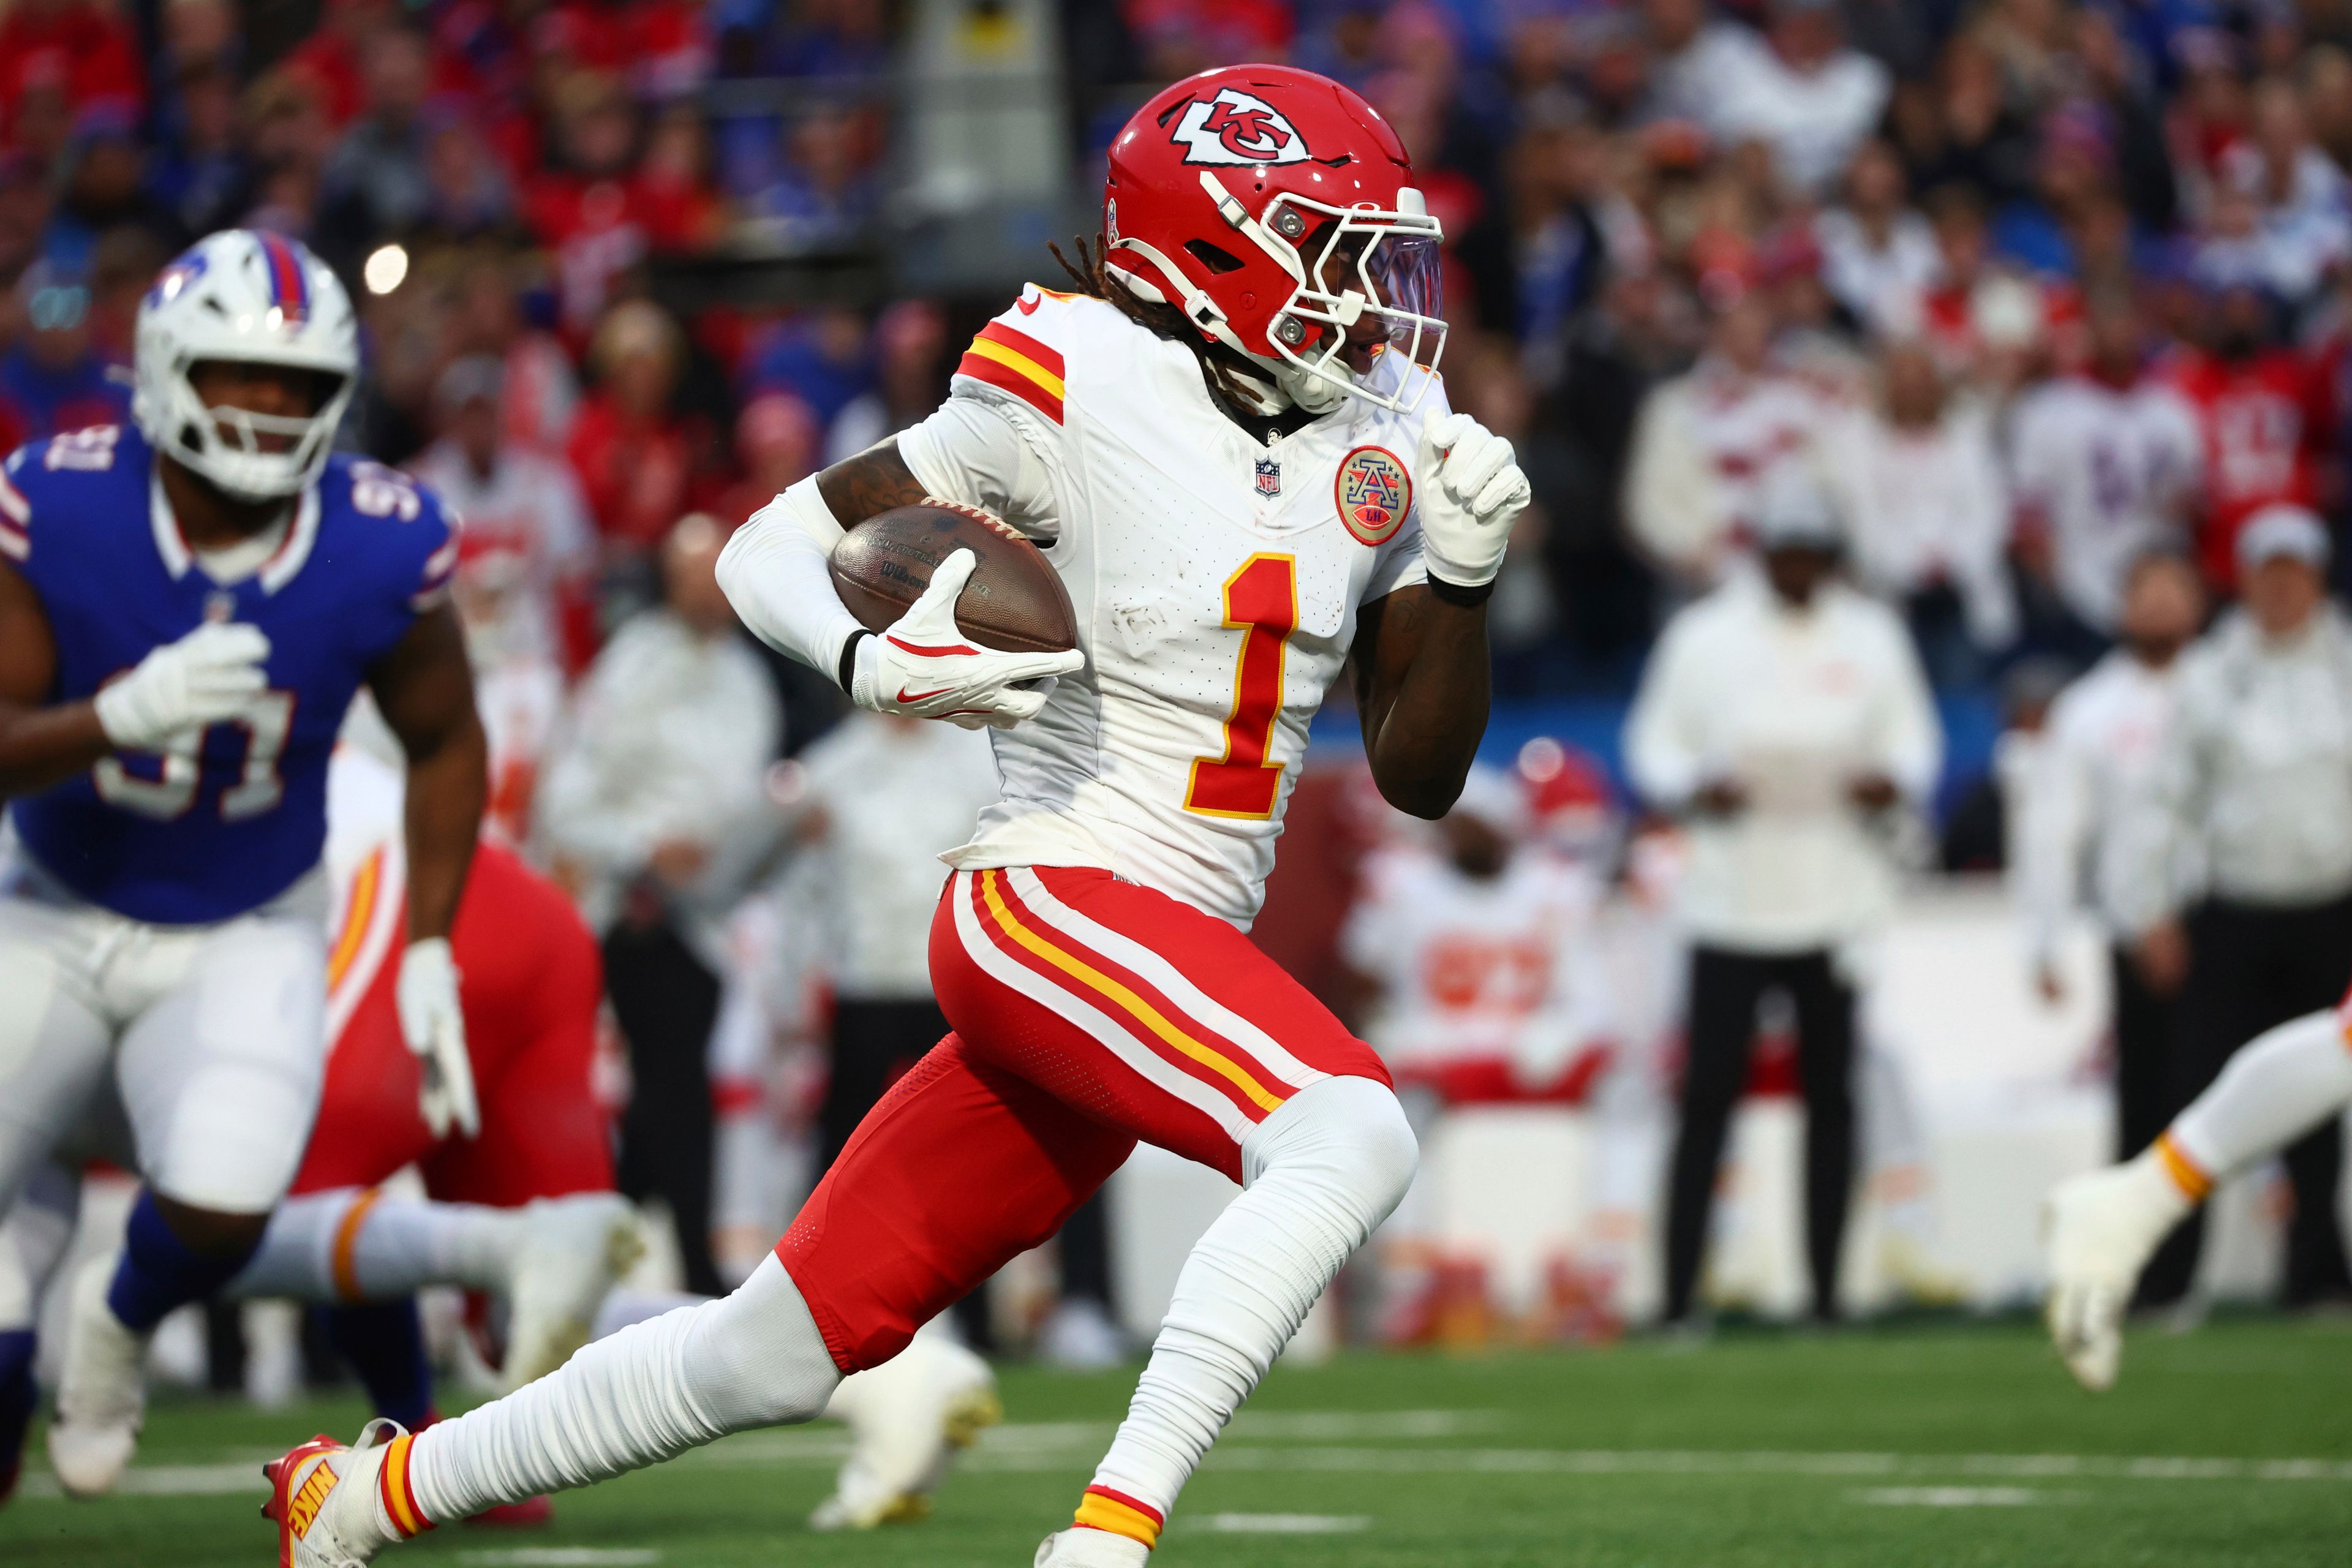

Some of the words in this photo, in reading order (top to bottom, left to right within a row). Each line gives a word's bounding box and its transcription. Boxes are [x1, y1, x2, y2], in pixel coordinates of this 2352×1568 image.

[1200, 101, 1292, 160] KC
[1257, 474, 1279, 492] NFL
[1366, 510, 1382, 522] LH
[1182, 551, 1298, 820] 1
[287, 1460, 339, 1540] NIKE
